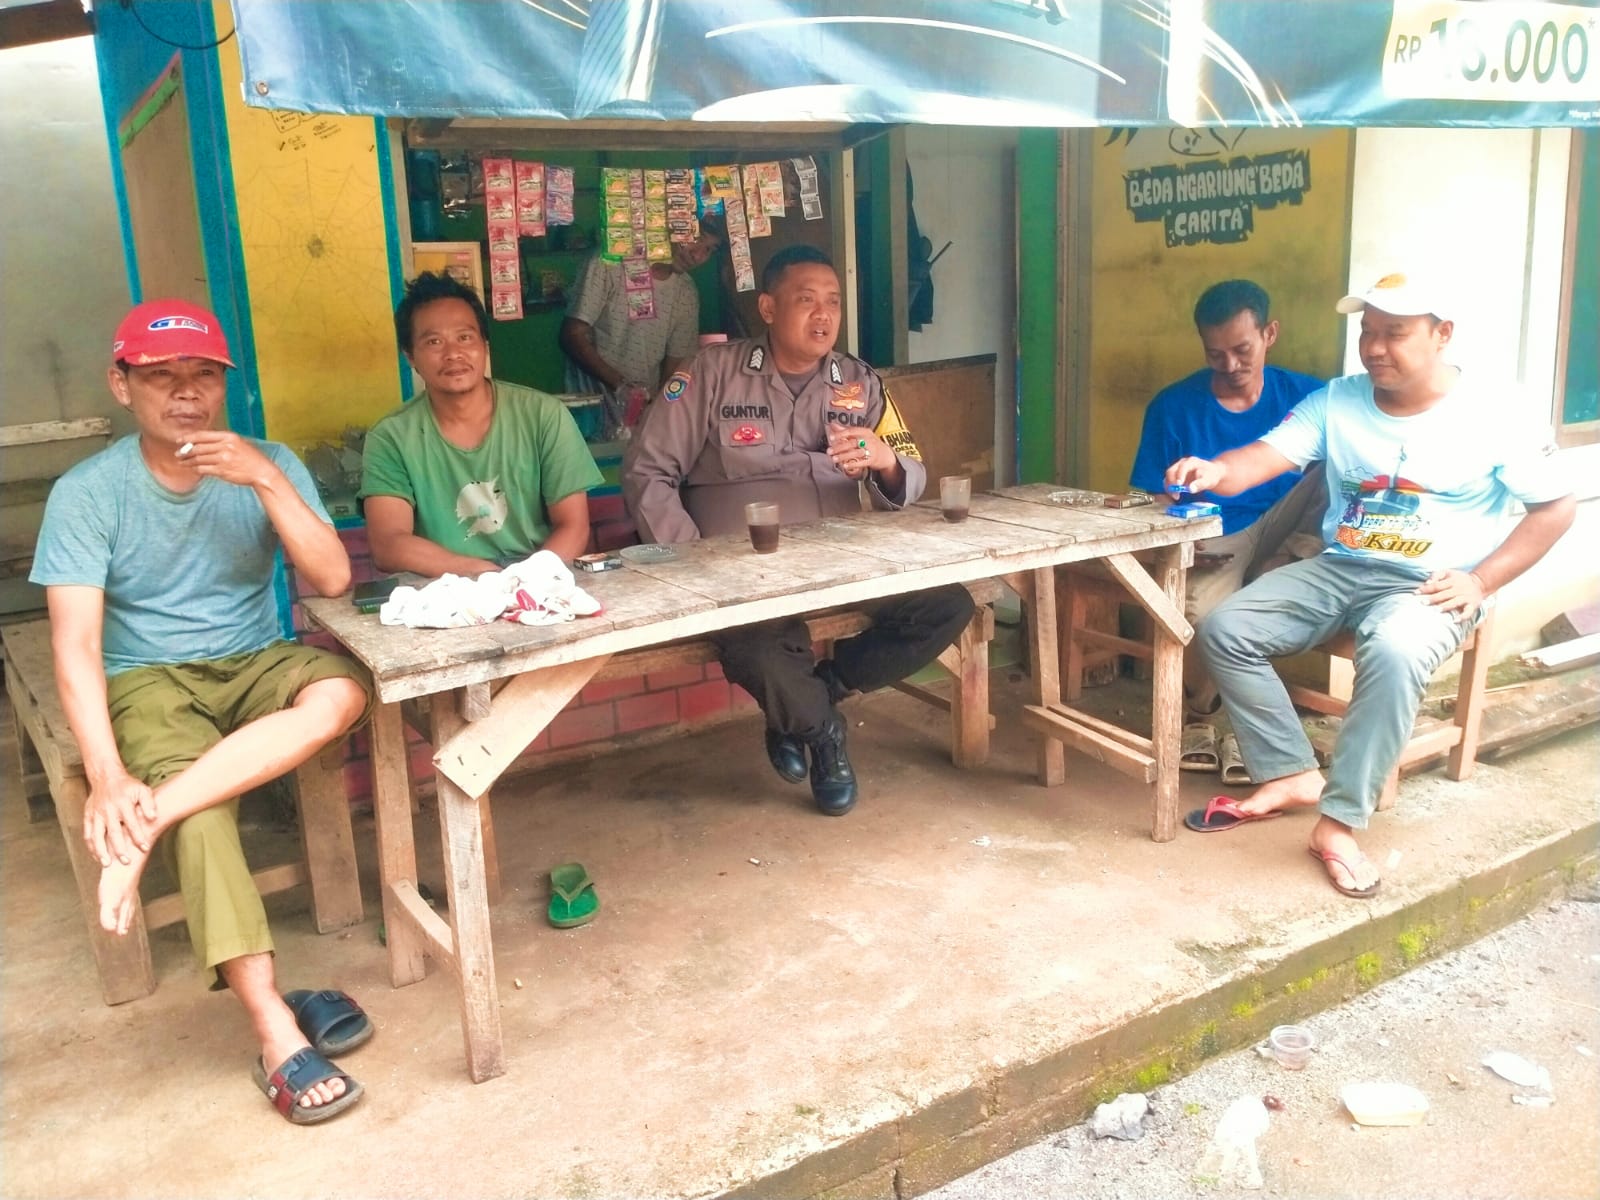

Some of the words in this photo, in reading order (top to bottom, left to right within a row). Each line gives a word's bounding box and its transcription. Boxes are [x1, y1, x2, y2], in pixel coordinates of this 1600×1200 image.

[1394, 34, 1422, 64] RP
[1129, 177, 1174, 208] BEDA
[1176, 166, 1257, 202] NGARIUNG
[1259, 160, 1305, 192] BEDA
[1174, 206, 1244, 237] CARITA
[721, 405, 770, 419] GUNTUR
